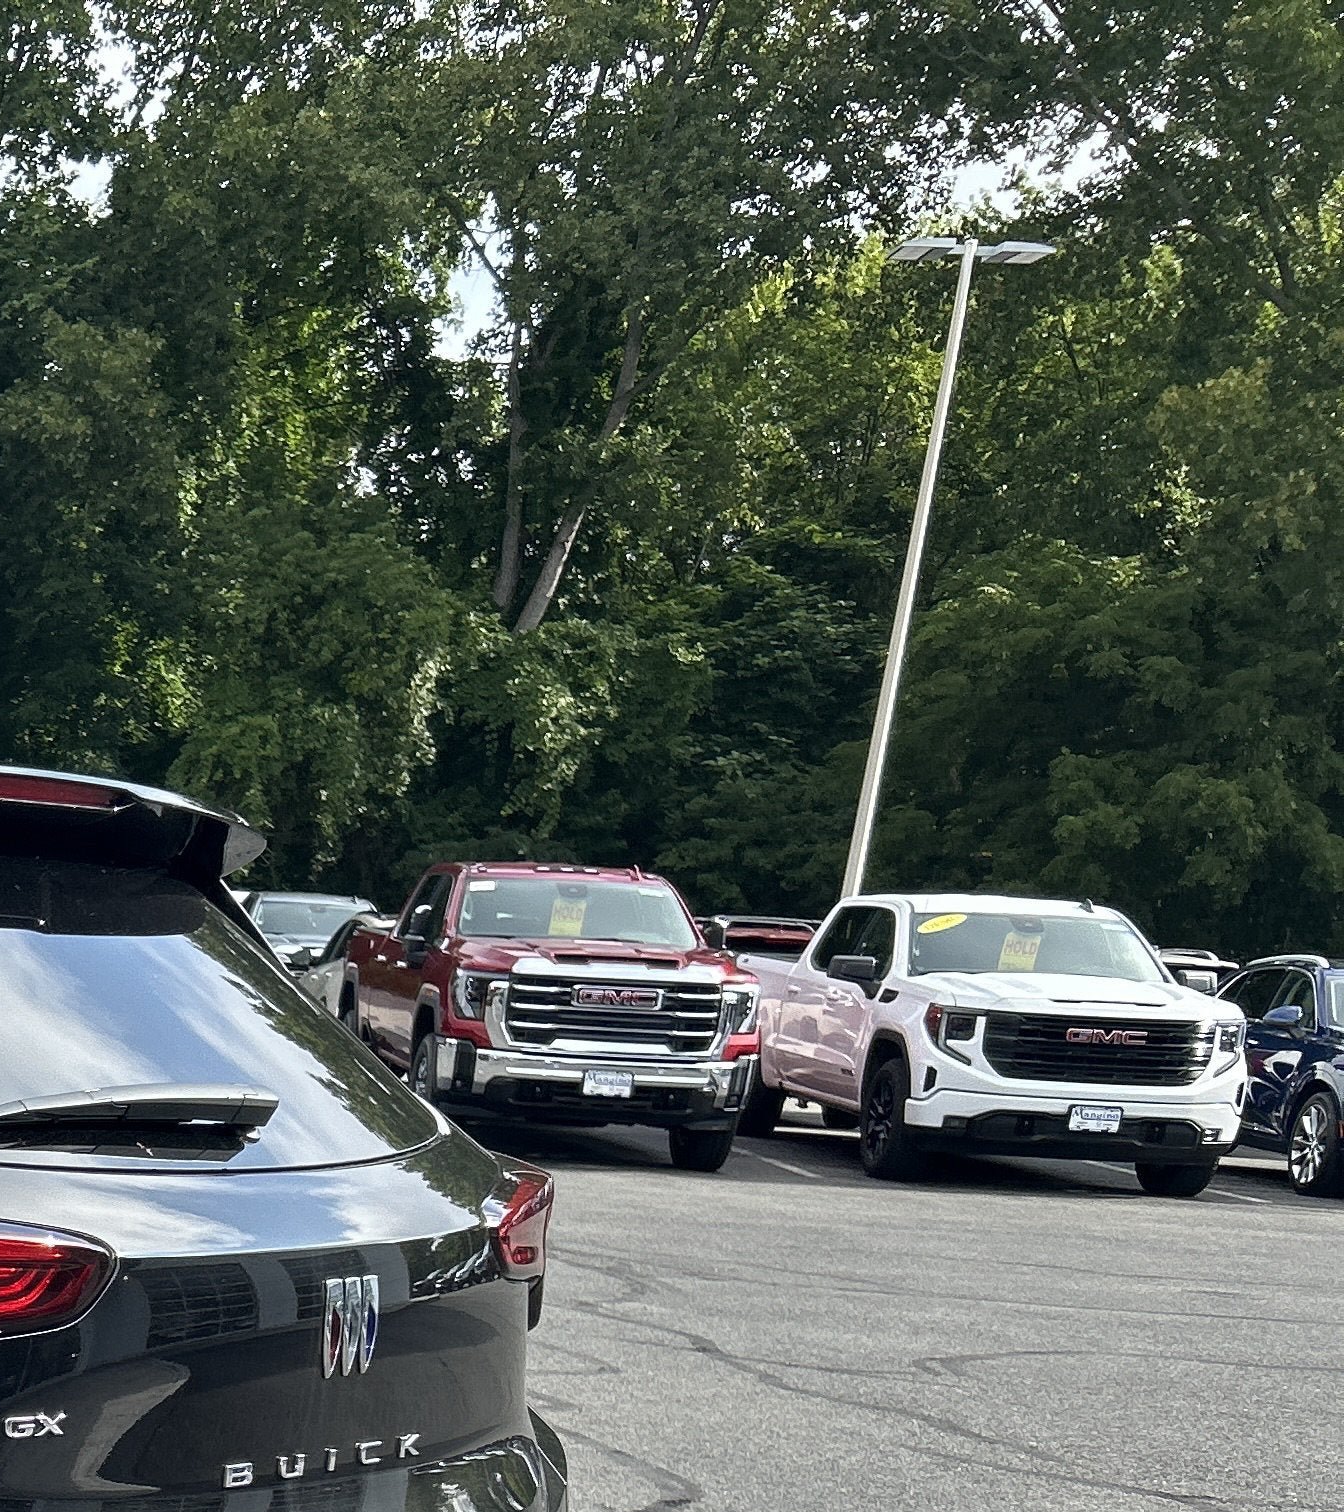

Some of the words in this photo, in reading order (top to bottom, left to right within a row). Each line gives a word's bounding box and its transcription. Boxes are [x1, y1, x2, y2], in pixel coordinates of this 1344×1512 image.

[554, 904, 583, 921] HOLD
[1004, 938, 1038, 955] HOLD
[578, 987, 658, 1007] GMC
[1066, 1028, 1148, 1046] GMC
[4, 1411, 67, 1438] GX
[223, 1432, 421, 1488] BUICK
